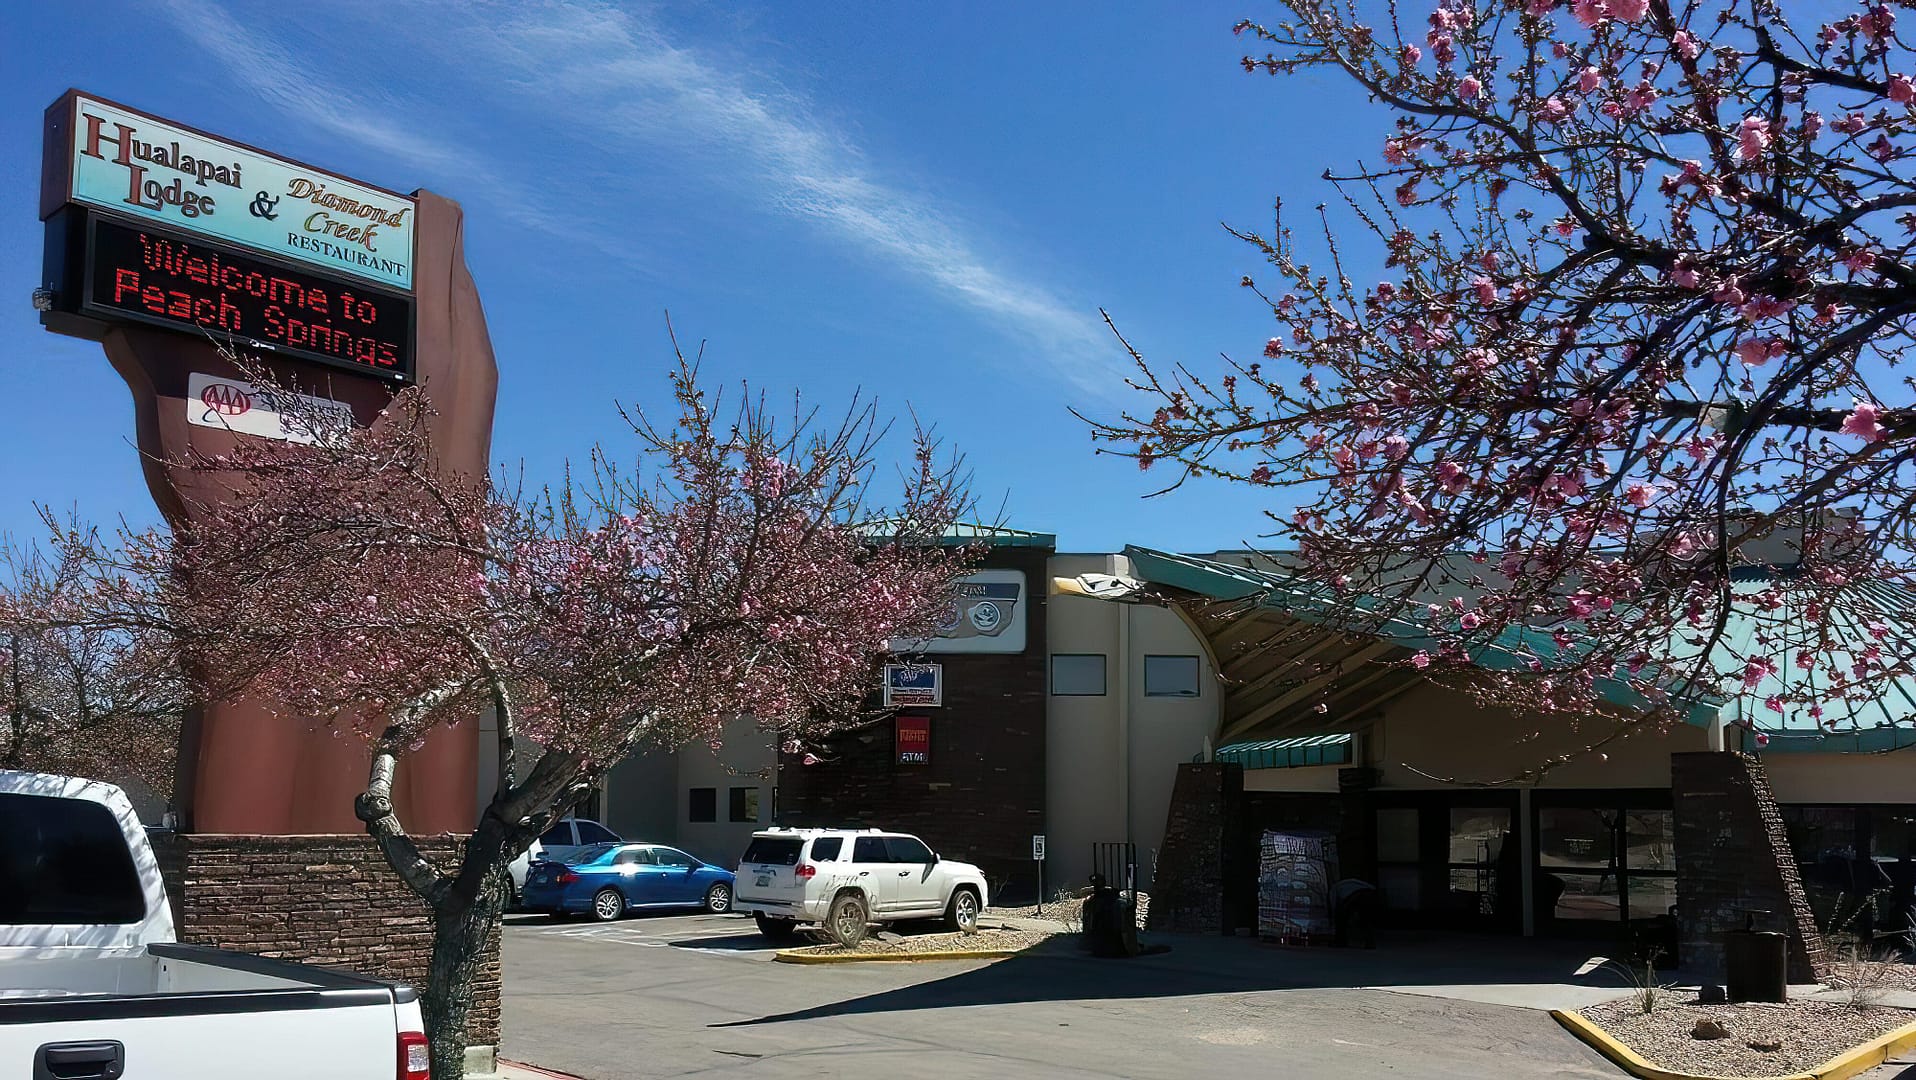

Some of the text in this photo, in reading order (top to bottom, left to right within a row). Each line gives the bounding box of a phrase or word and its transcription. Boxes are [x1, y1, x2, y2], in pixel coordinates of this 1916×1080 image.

[81, 113, 243, 189] Hualapai
[123, 163, 216, 218] Lodge
[249, 190, 280, 221] &
[286, 178, 411, 228] Diamond
[287, 232, 406, 277] RESTAURANT
[304, 212, 379, 252] Creek
[140, 233, 377, 324] Welcome to
[114, 268, 398, 366] Peach Springs
[203, 385, 249, 414] AAA
